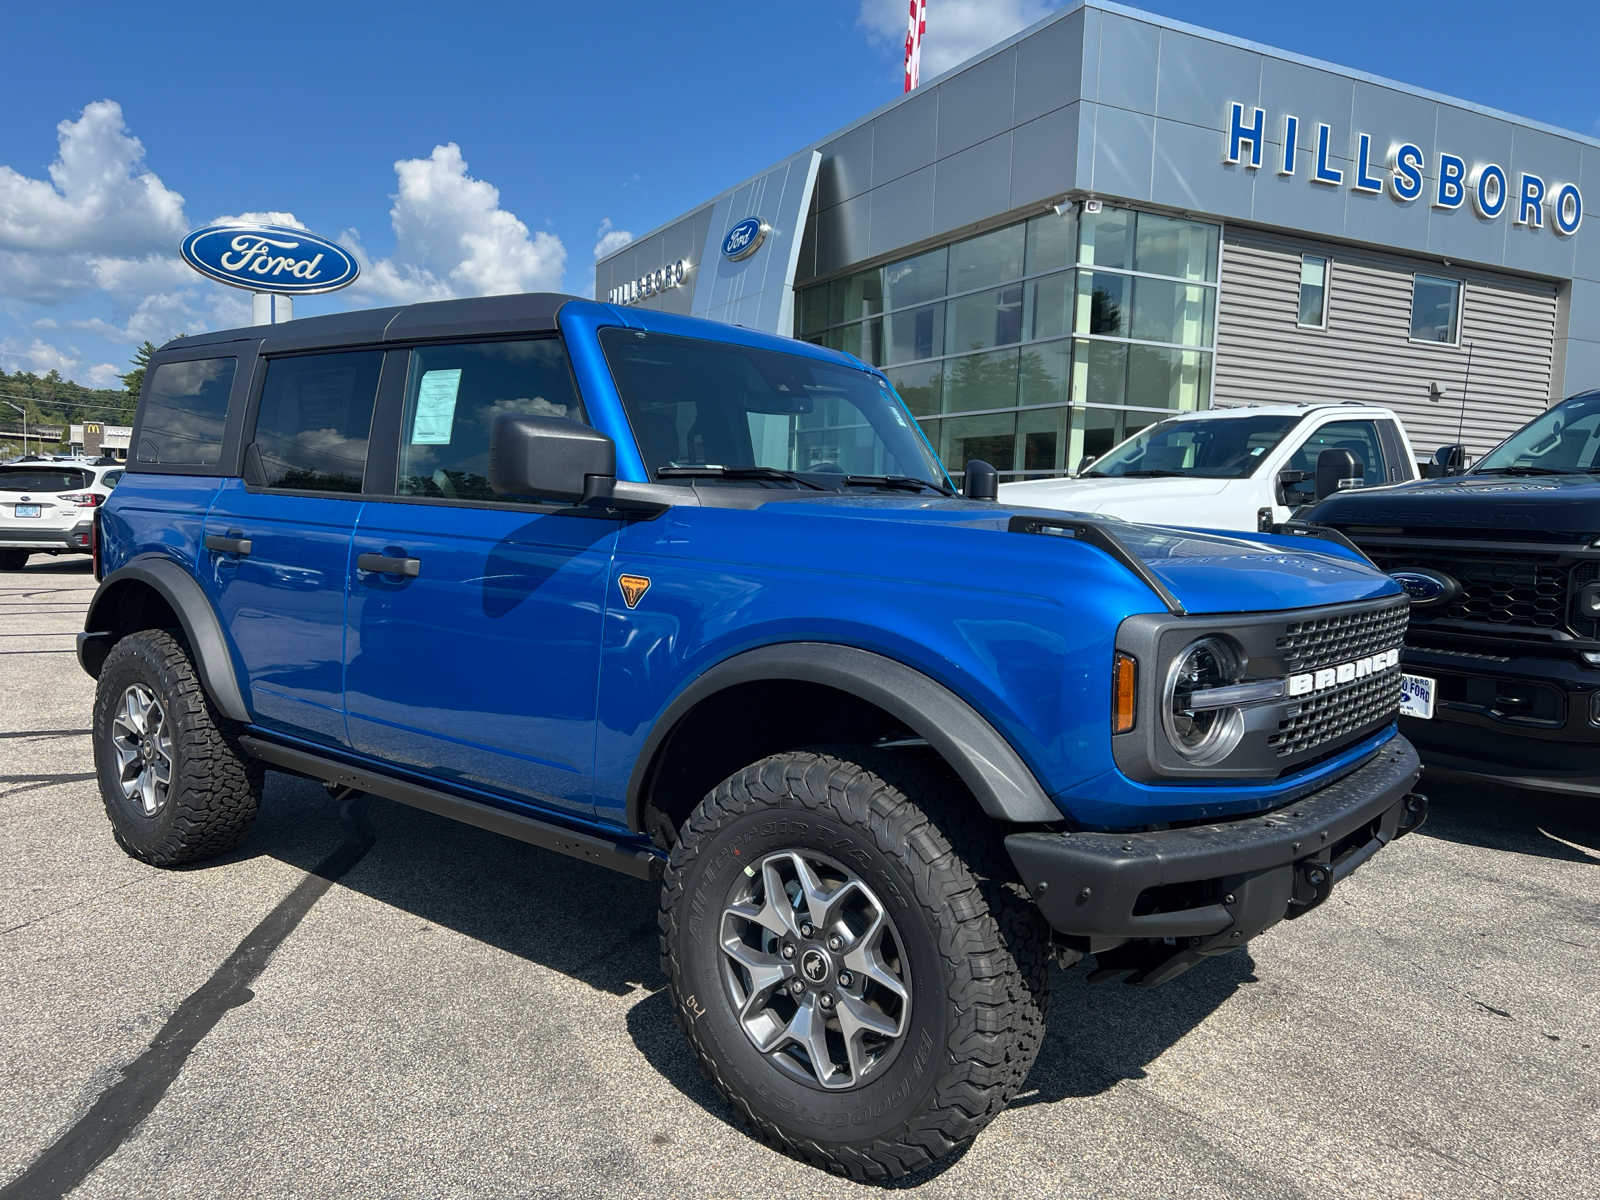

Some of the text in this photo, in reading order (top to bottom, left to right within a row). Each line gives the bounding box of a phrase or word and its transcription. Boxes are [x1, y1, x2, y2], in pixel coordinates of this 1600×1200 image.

[1224, 101, 1583, 236] HILLSBORO
[220, 234, 324, 280] Ford
[727, 225, 753, 252] Ford
[607, 259, 685, 305] HILLSBORO
[1288, 649, 1399, 697] BRONCO
[1410, 682, 1430, 703] FORD
